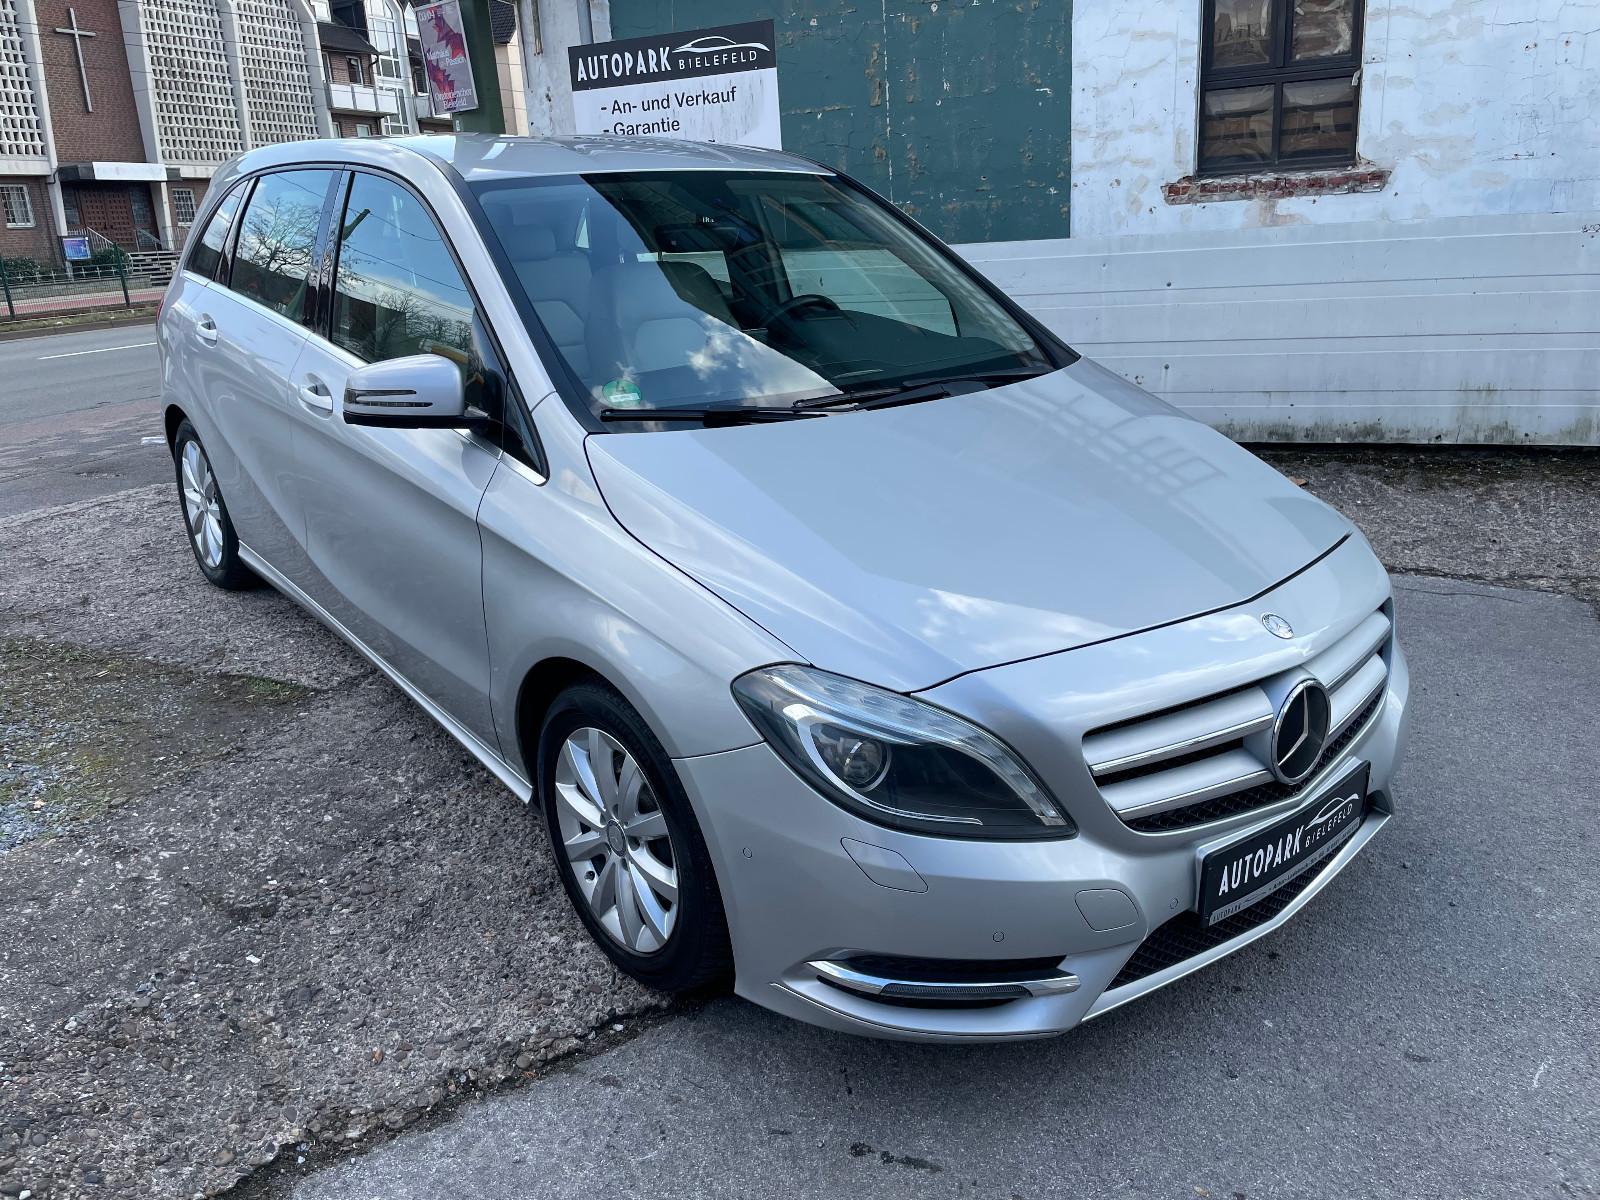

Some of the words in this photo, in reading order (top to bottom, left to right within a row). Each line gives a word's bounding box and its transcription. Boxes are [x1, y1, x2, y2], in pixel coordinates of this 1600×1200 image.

[577, 46, 672, 82] AUTOPARK
[679, 50, 757, 70] BIELEFELD
[641, 94, 670, 112] und
[675, 86, 737, 108] Verkauf
[613, 117, 680, 135] Garantie
[1218, 824, 1304, 896] AUTOPARK
[1305, 803, 1353, 848] BIELEFELD
